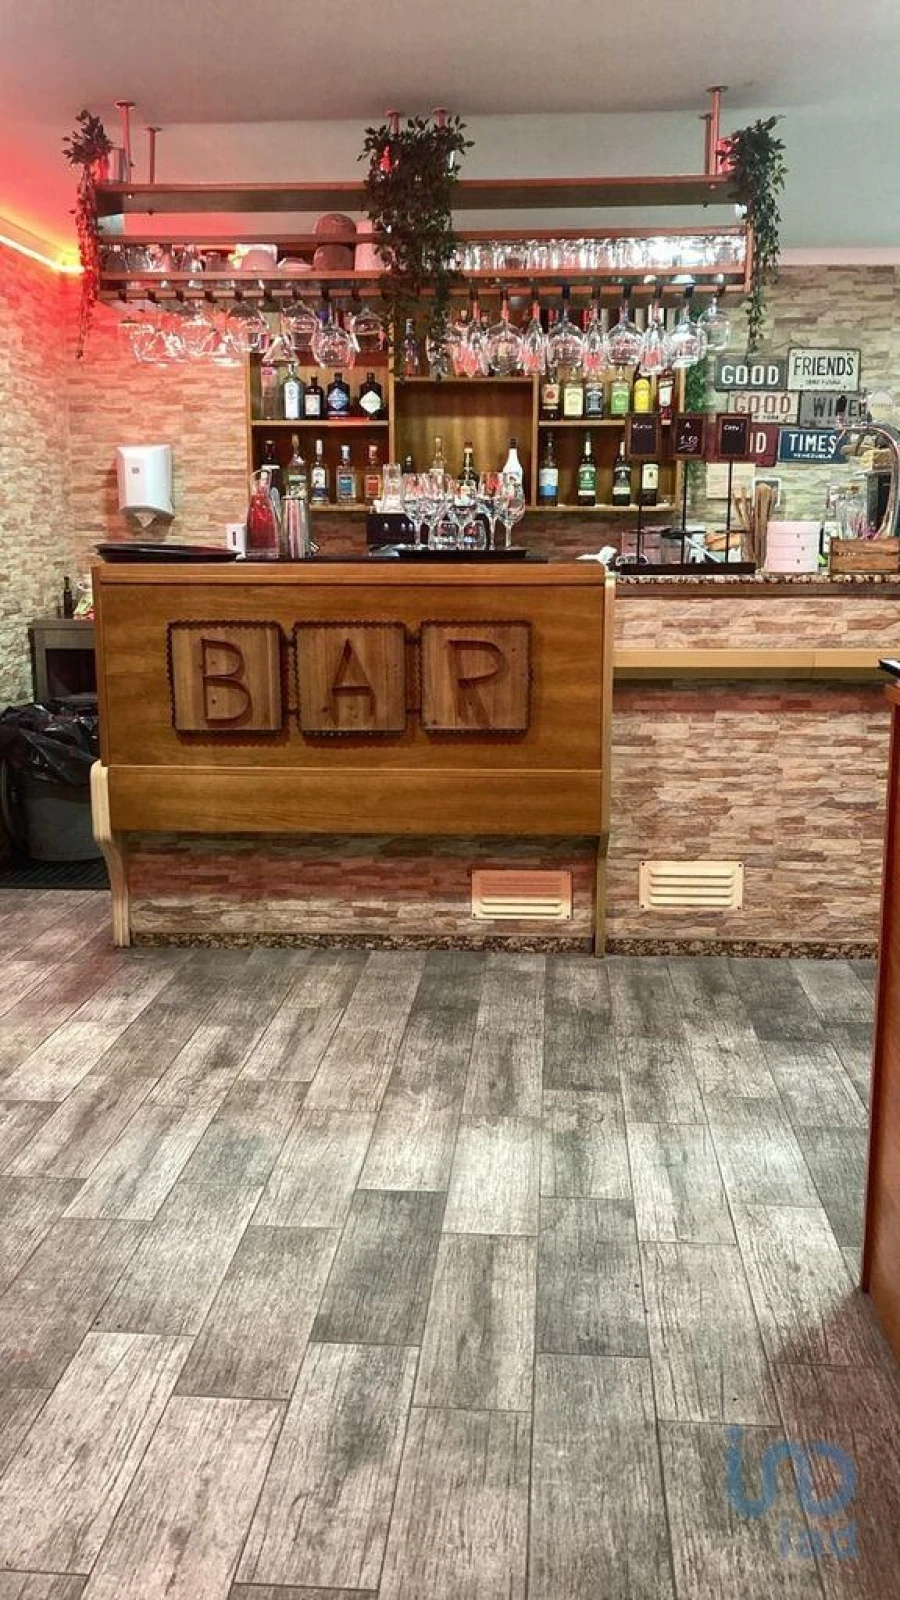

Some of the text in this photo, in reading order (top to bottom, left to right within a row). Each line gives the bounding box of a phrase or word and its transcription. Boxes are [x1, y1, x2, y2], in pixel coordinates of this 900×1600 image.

[721, 365, 779, 385] GOOD
[793, 356, 854, 376] FRIENDS
[734, 394, 791, 414] GOOD
[789, 433, 838, 454] TIMES
[200, 637, 505, 729] BAR
